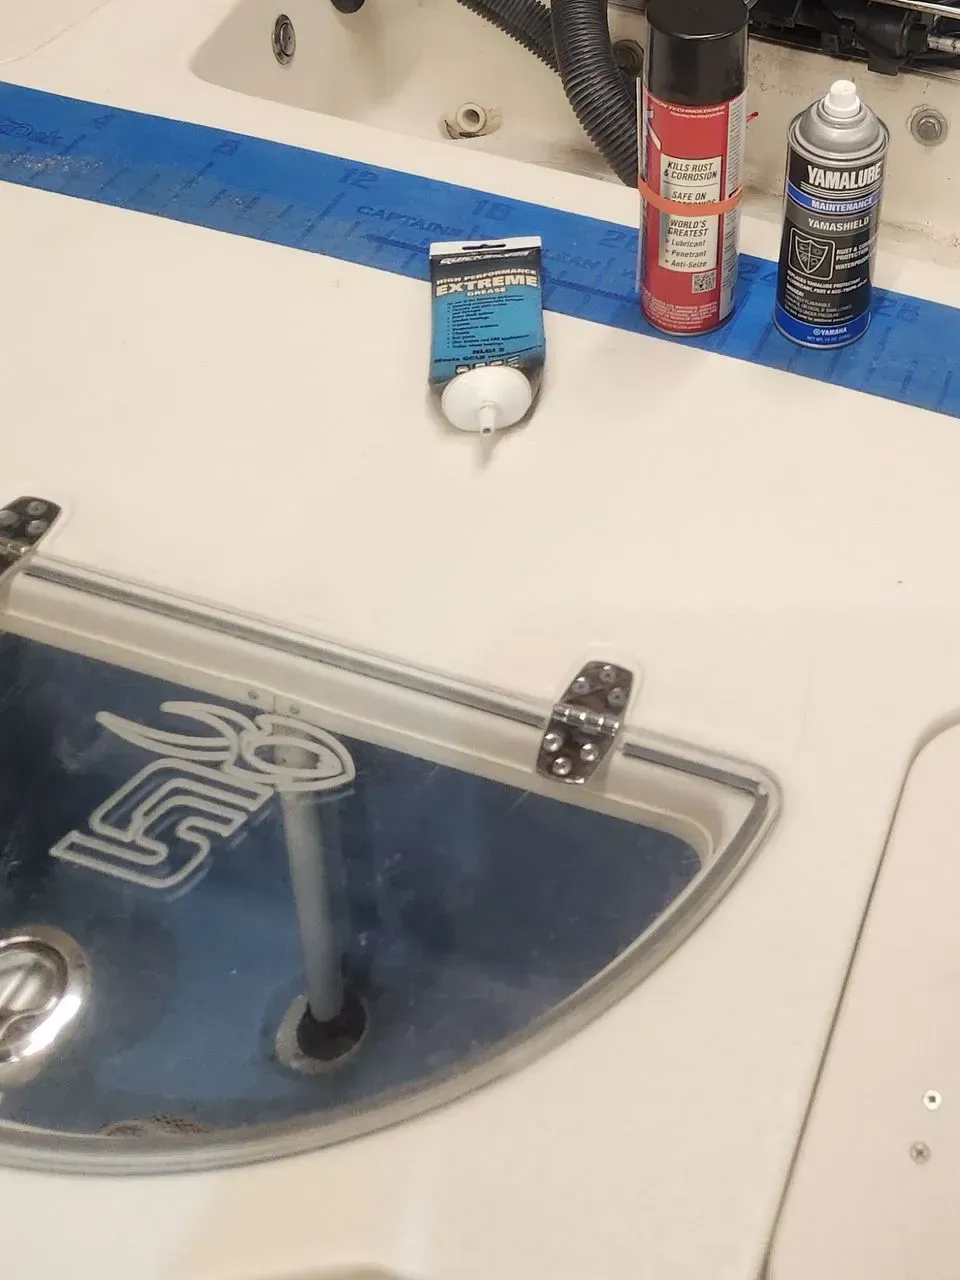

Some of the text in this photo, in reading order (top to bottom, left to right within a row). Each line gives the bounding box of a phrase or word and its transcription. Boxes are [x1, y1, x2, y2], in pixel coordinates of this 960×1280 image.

[667, 161, 714, 173] KILLS RUST
[671, 171, 718, 181] CORROSION
[807, 161, 884, 190] YAMALUBE
[671, 191, 693, 201] SAFE
[695, 192, 707, 201] ON
[811, 197, 873, 212] MAINTENANCE
[670, 219, 707, 229] WORLD'S
[808, 216, 870, 232] YAMASHIELD
[667, 227, 709, 238] GREATEST
[671, 238, 706, 248] Lubricant
[671, 249, 707, 258] Penetrant
[670, 259, 707, 269] Anti-Seize
[436, 268, 537, 286] HIGH PERFORMANCE
[436, 275, 538, 297] EXTREME
[467, 287, 507, 296] GREASE
[821, 326, 847, 336] YAMAHA
